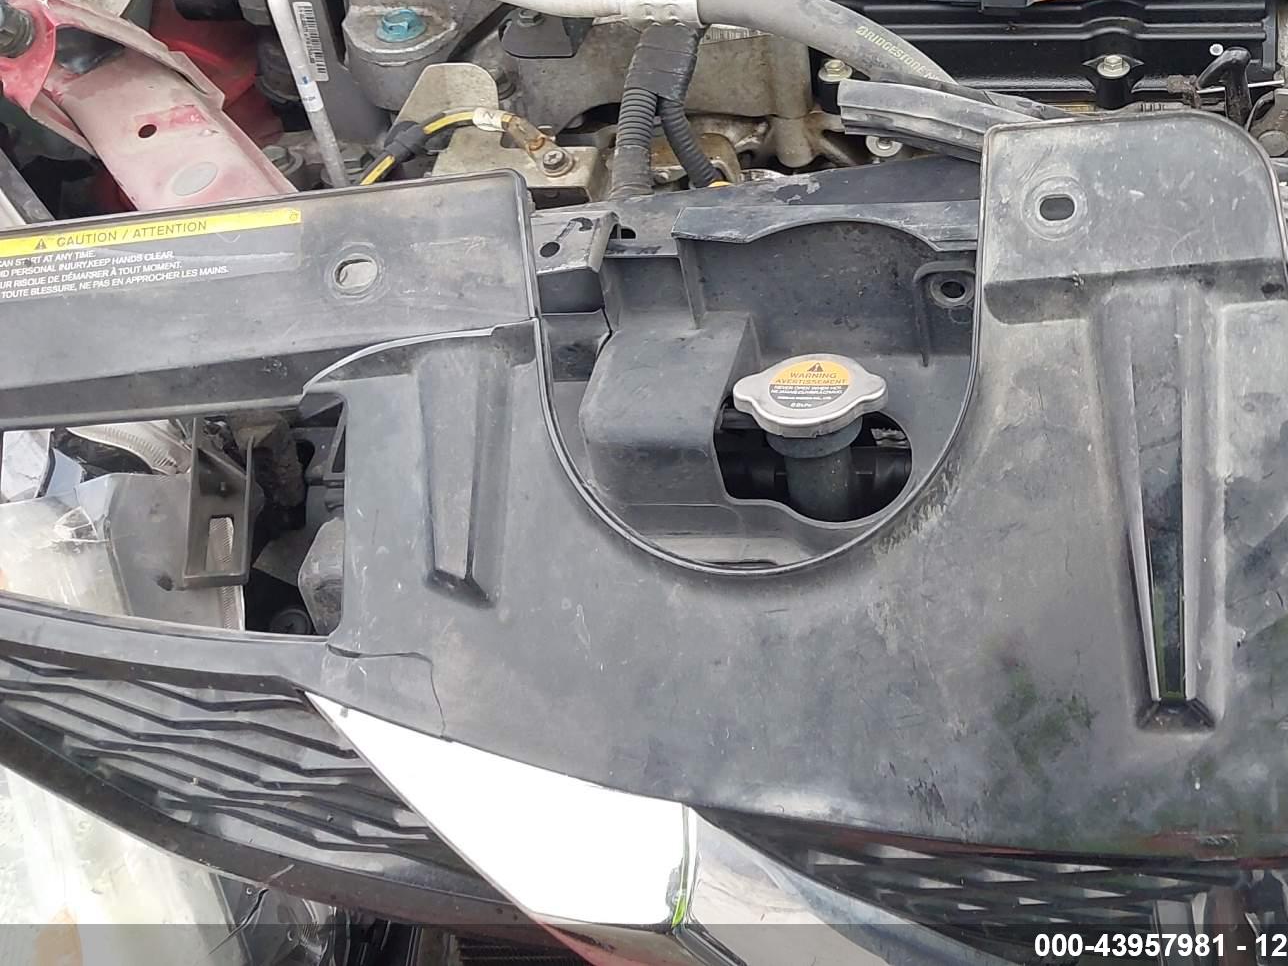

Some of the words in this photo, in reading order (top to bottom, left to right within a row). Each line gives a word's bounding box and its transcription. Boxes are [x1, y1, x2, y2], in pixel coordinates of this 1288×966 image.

[855, 25, 928, 75] BRIDGESTONE
[56, 230, 117, 247] CAUTION
[132, 220, 207, 239] ATTENTION
[10, 264, 57, 276] PERSONAL
[112, 253, 143, 265] HANDS
[42, 255, 53, 263] AT
[55, 252, 73, 262] ANY
[1, 289, 30, 299] TOUTE
[30, 283, 77, 296] BLESSURE,
[79, 281, 92, 290] NE
[93, 279, 110, 288] PAS
[111, 277, 124, 286] EN
[124, 271, 180, 284] APPROCHER
[181, 269, 198, 278] LES
[199, 265, 229, 275] MAINS.
[13, 276, 46, 288] RISQUE
[47, 275, 60, 284] DE
[118, 265, 142, 275] TOUT
[142, 261, 182, 273] MOMENT.
